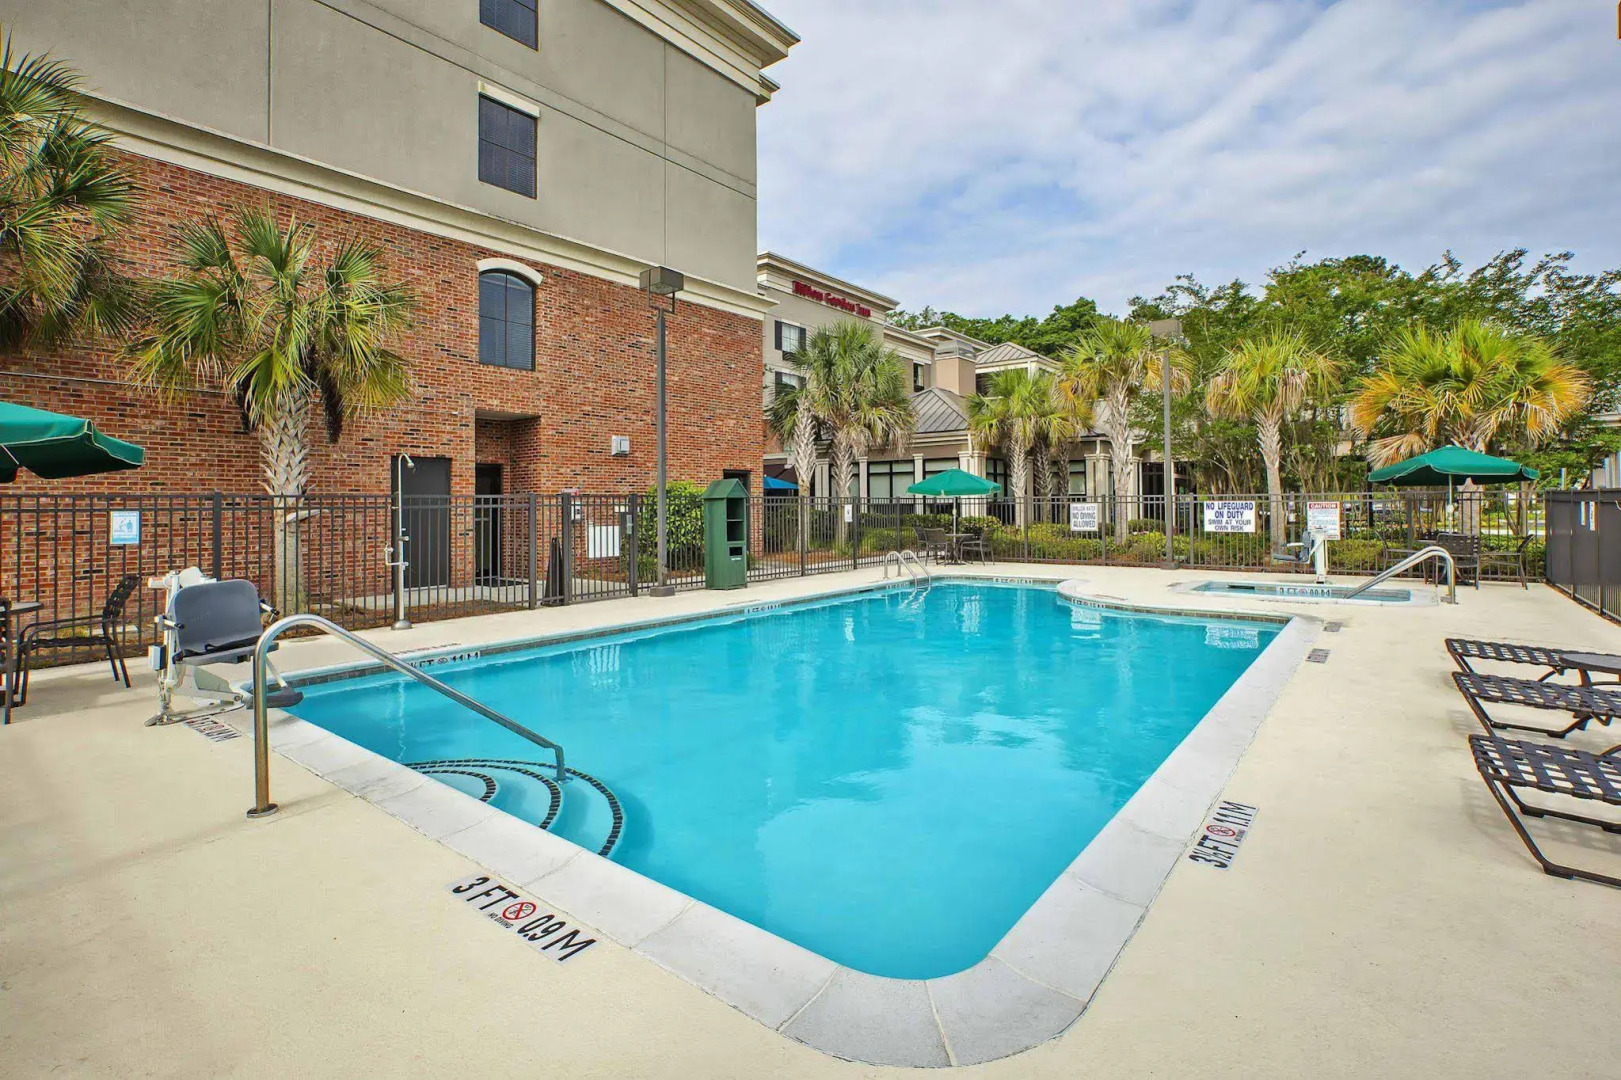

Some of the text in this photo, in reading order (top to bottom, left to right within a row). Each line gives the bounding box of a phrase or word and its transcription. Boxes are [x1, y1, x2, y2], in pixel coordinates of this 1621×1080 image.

[1205, 502, 1254, 511] NO LIFEGUARD
[1072, 512, 1096, 520] NO DIVING
[1073, 520, 1096, 528] ALLOWED
[466, 884, 521, 911] FT
[541, 929, 597, 962] M
